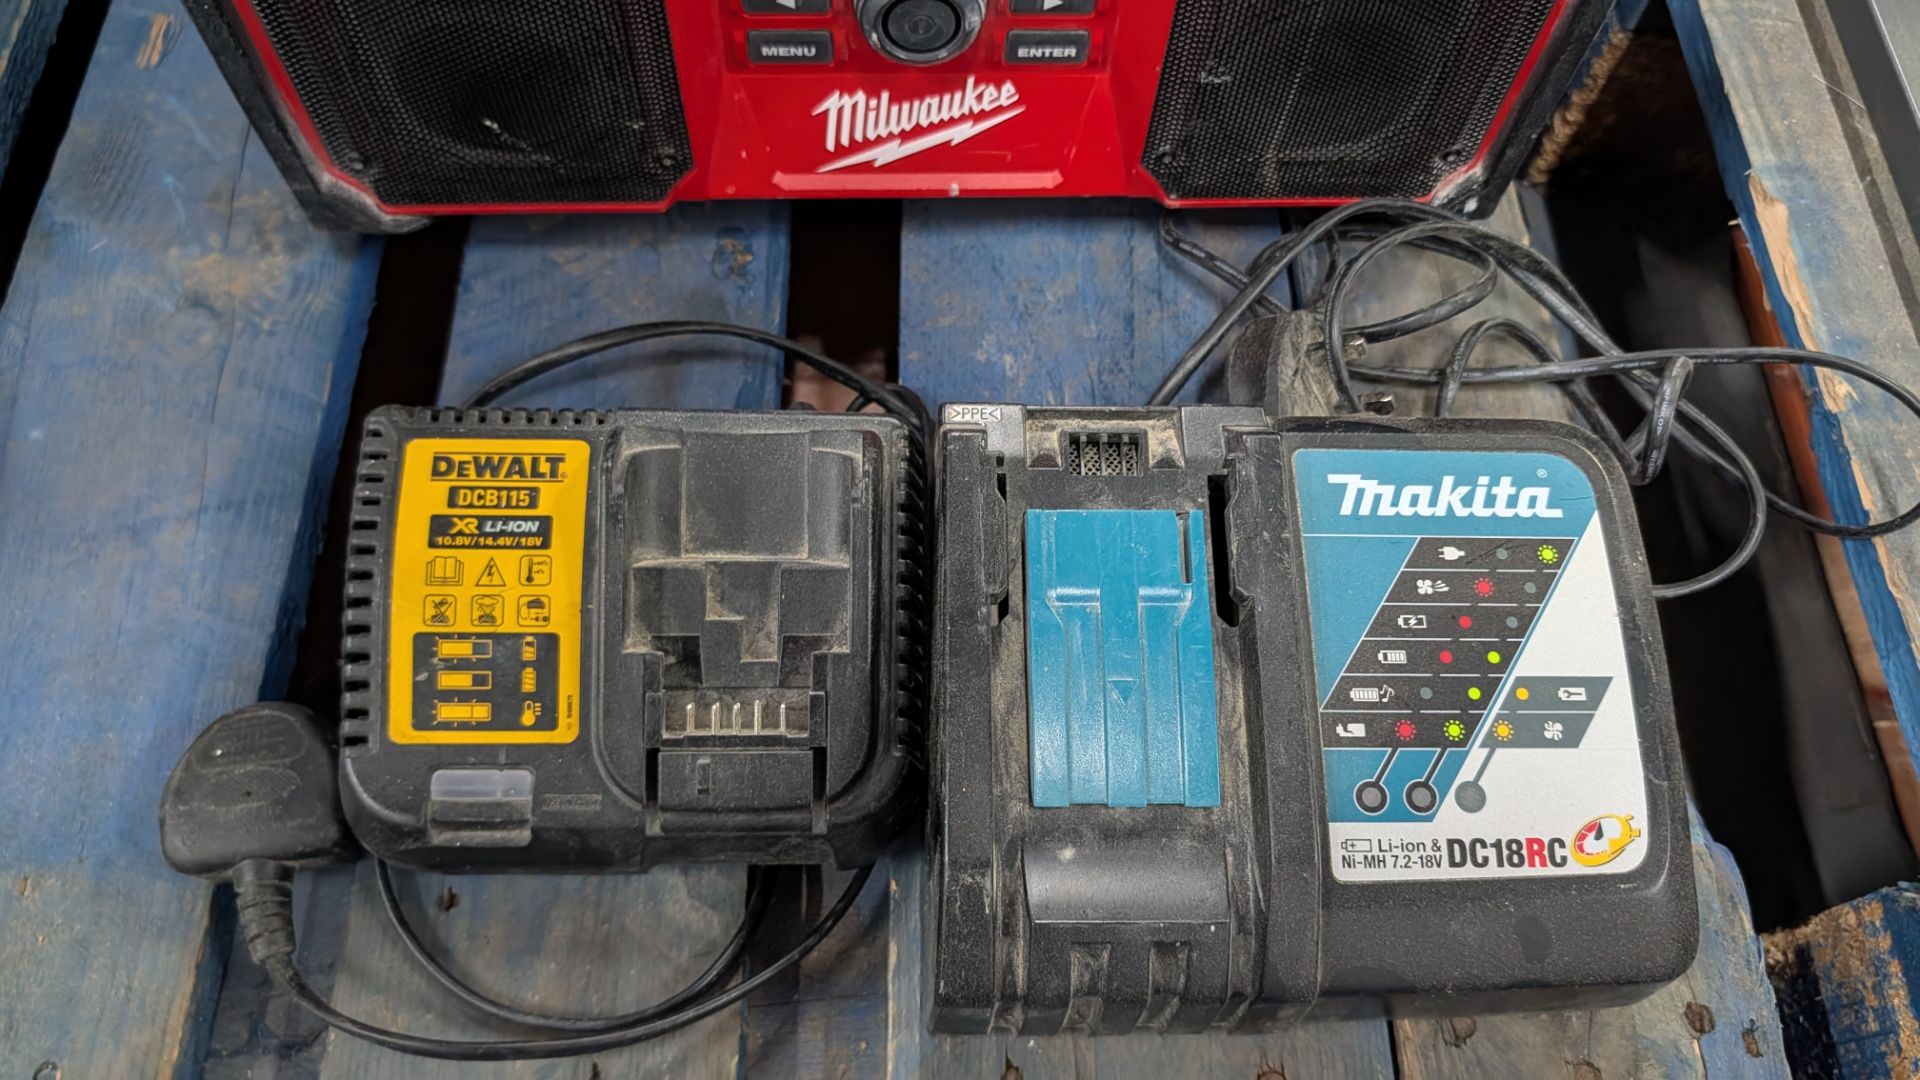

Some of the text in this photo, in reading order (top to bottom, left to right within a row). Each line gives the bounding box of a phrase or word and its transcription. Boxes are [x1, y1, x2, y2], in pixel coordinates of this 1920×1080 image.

[761, 45, 817, 57] MENU
[1017, 46, 1077, 58] ENTER
[811, 75, 1020, 153] Milwaukee
[458, 488, 530, 506] DCB115
[449, 517, 540, 534] XR LI-ION
[1378, 838, 1442, 853] Li-ion &
[1446, 837, 1568, 869] DC18RC
[1341, 855, 1443, 869] Ni-MH 7.2-18V
